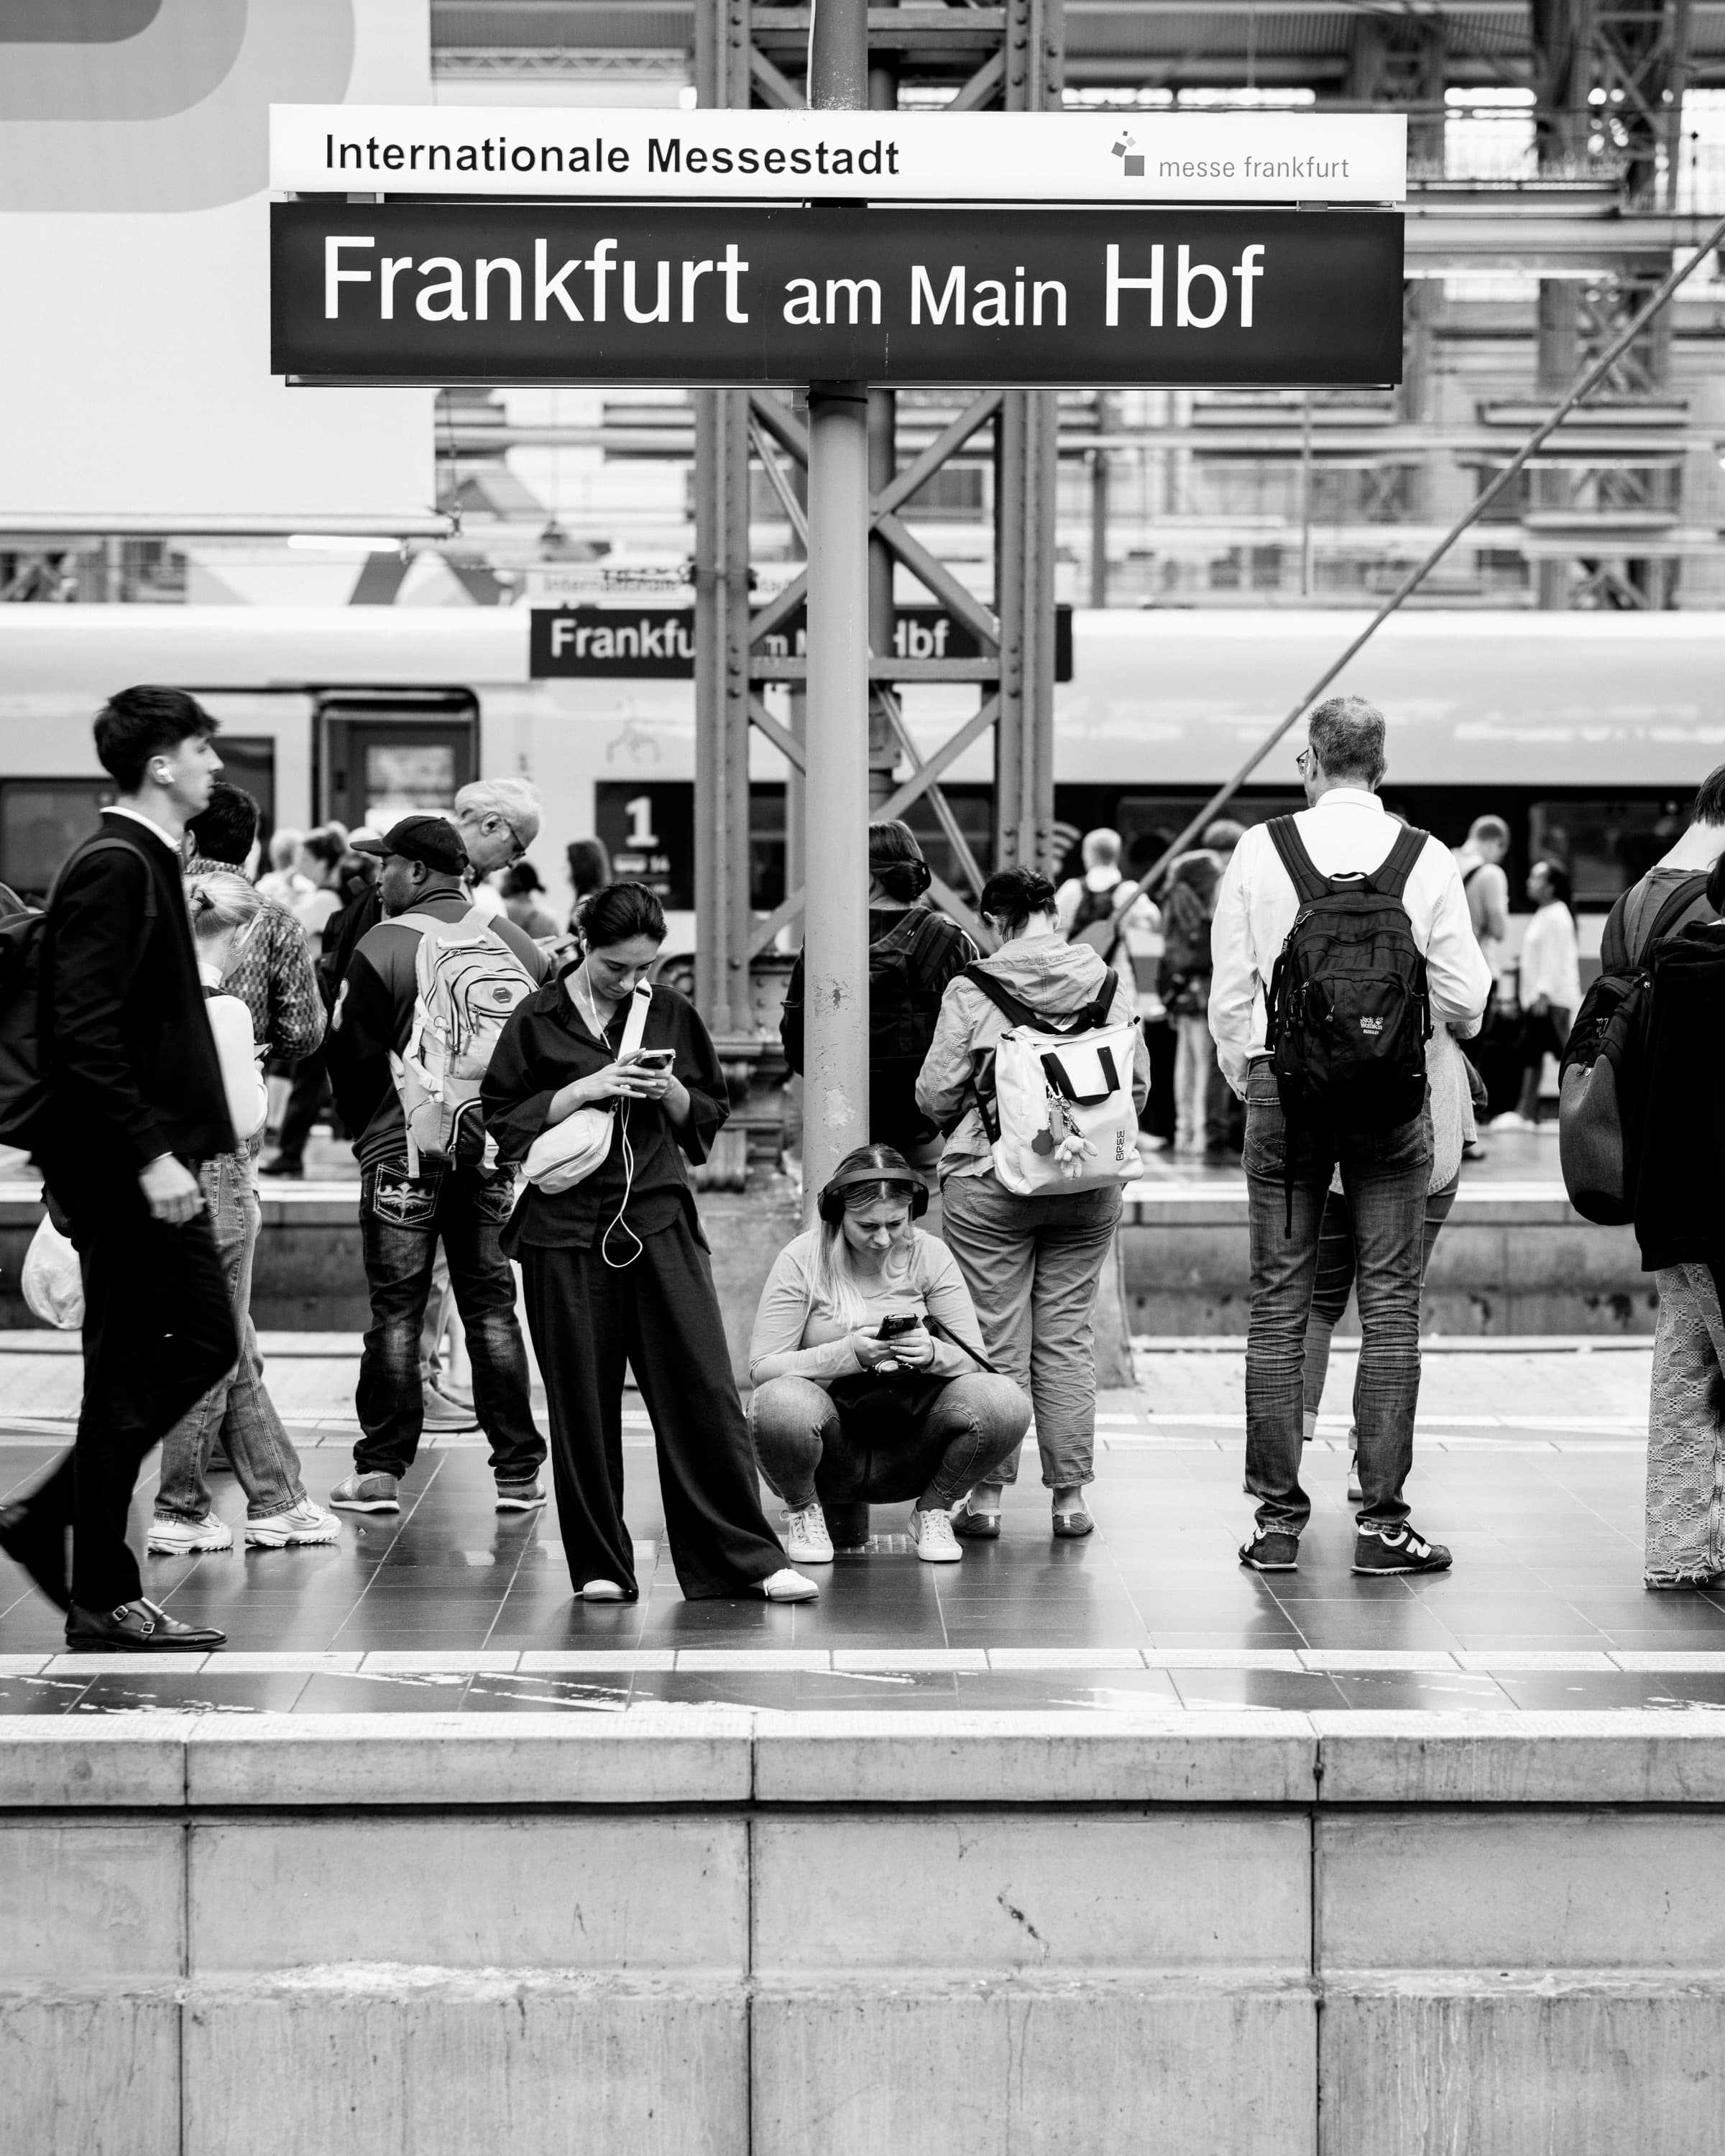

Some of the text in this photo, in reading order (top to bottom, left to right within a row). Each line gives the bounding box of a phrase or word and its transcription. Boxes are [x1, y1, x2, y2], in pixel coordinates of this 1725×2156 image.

[326, 134, 900, 175] Internationale Messestadt
[1159, 155, 1350, 178] messe frankfurt
[325, 235, 1265, 328] Frankfurt am Main Hbf
[551, 618, 695, 658] Frankfu
[625, 796, 659, 847] 1
[1116, 1130, 1124, 1161] BREE
